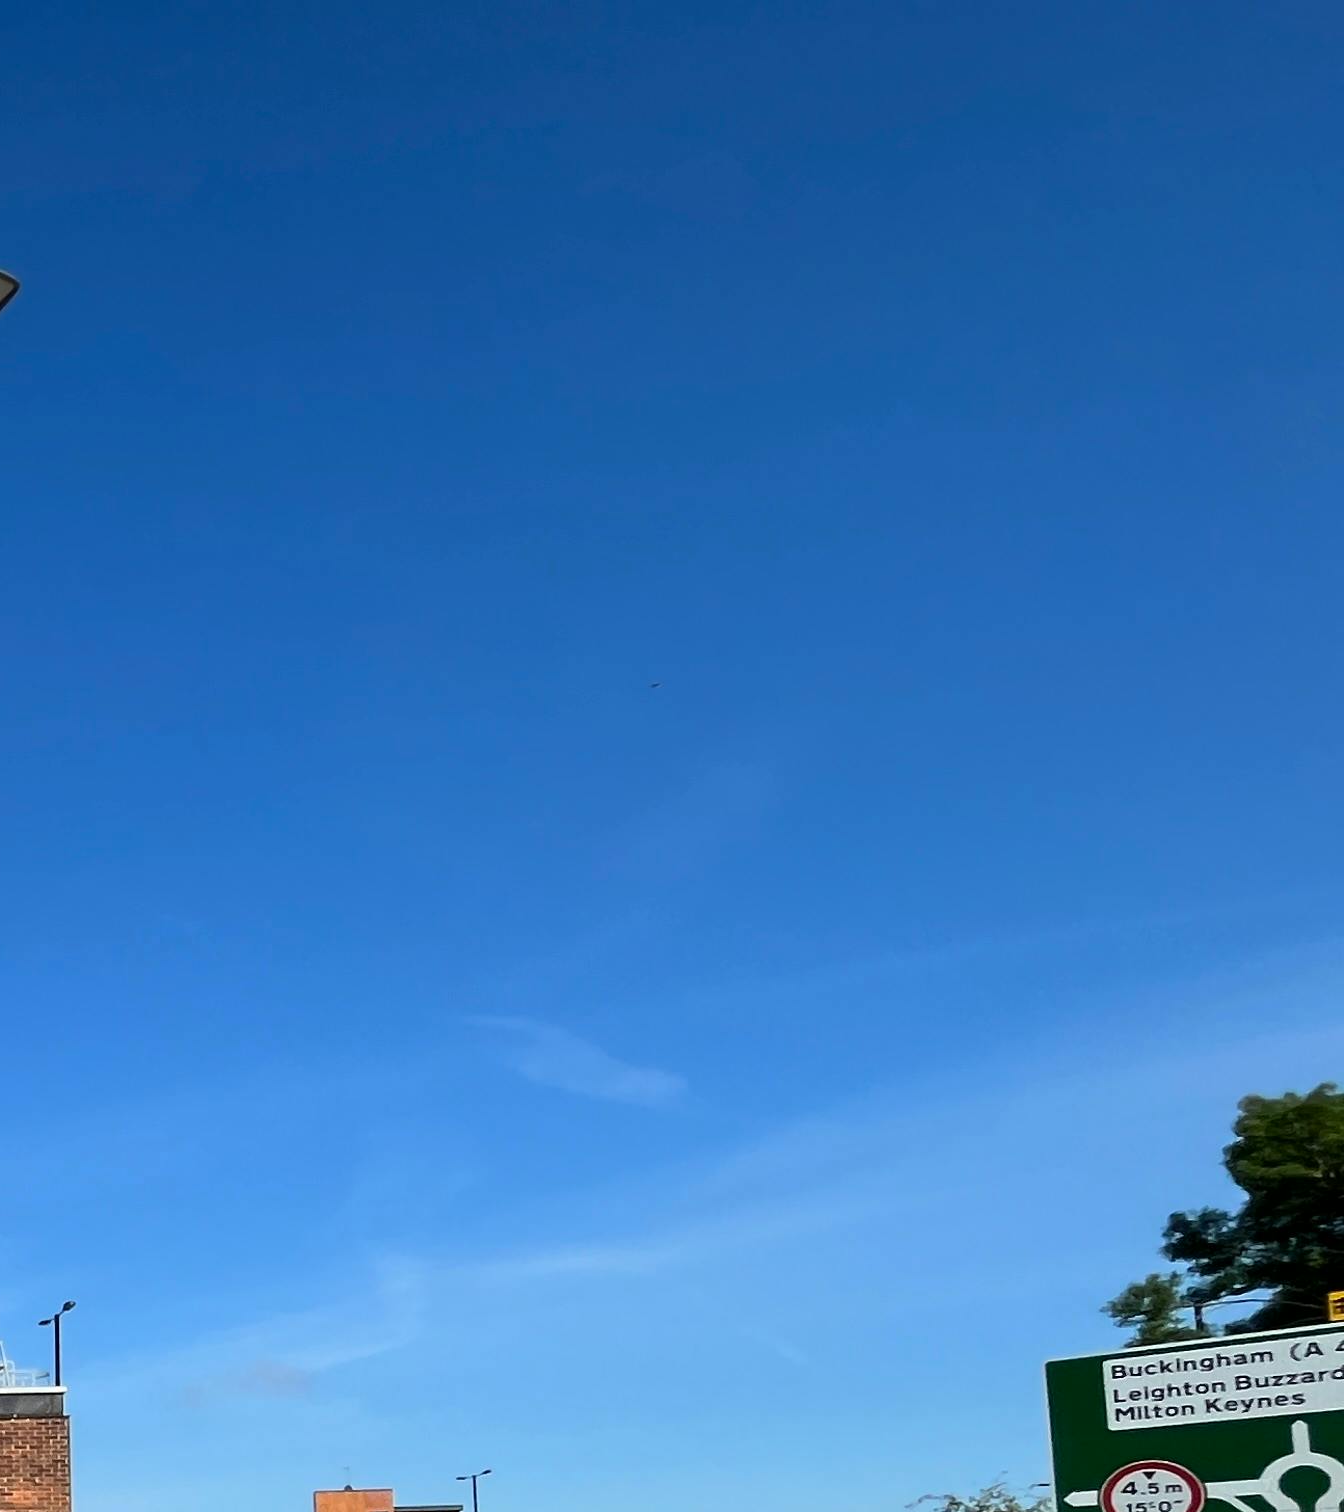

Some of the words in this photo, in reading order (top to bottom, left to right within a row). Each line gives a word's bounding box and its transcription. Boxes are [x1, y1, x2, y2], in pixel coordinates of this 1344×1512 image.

[1111, 1351, 1274, 1379] Buckingham
[1290, 1342, 1324, 1361] (A
[1113, 1381, 1226, 1403] Leighton
[1235, 1365, 1344, 1391] Buzzard
[1115, 1404, 1195, 1422] Milton
[1205, 1393, 1306, 1414] Keynes
[1121, 1482, 1159, 1495] 4.5
[1165, 1484, 1183, 1494] m
